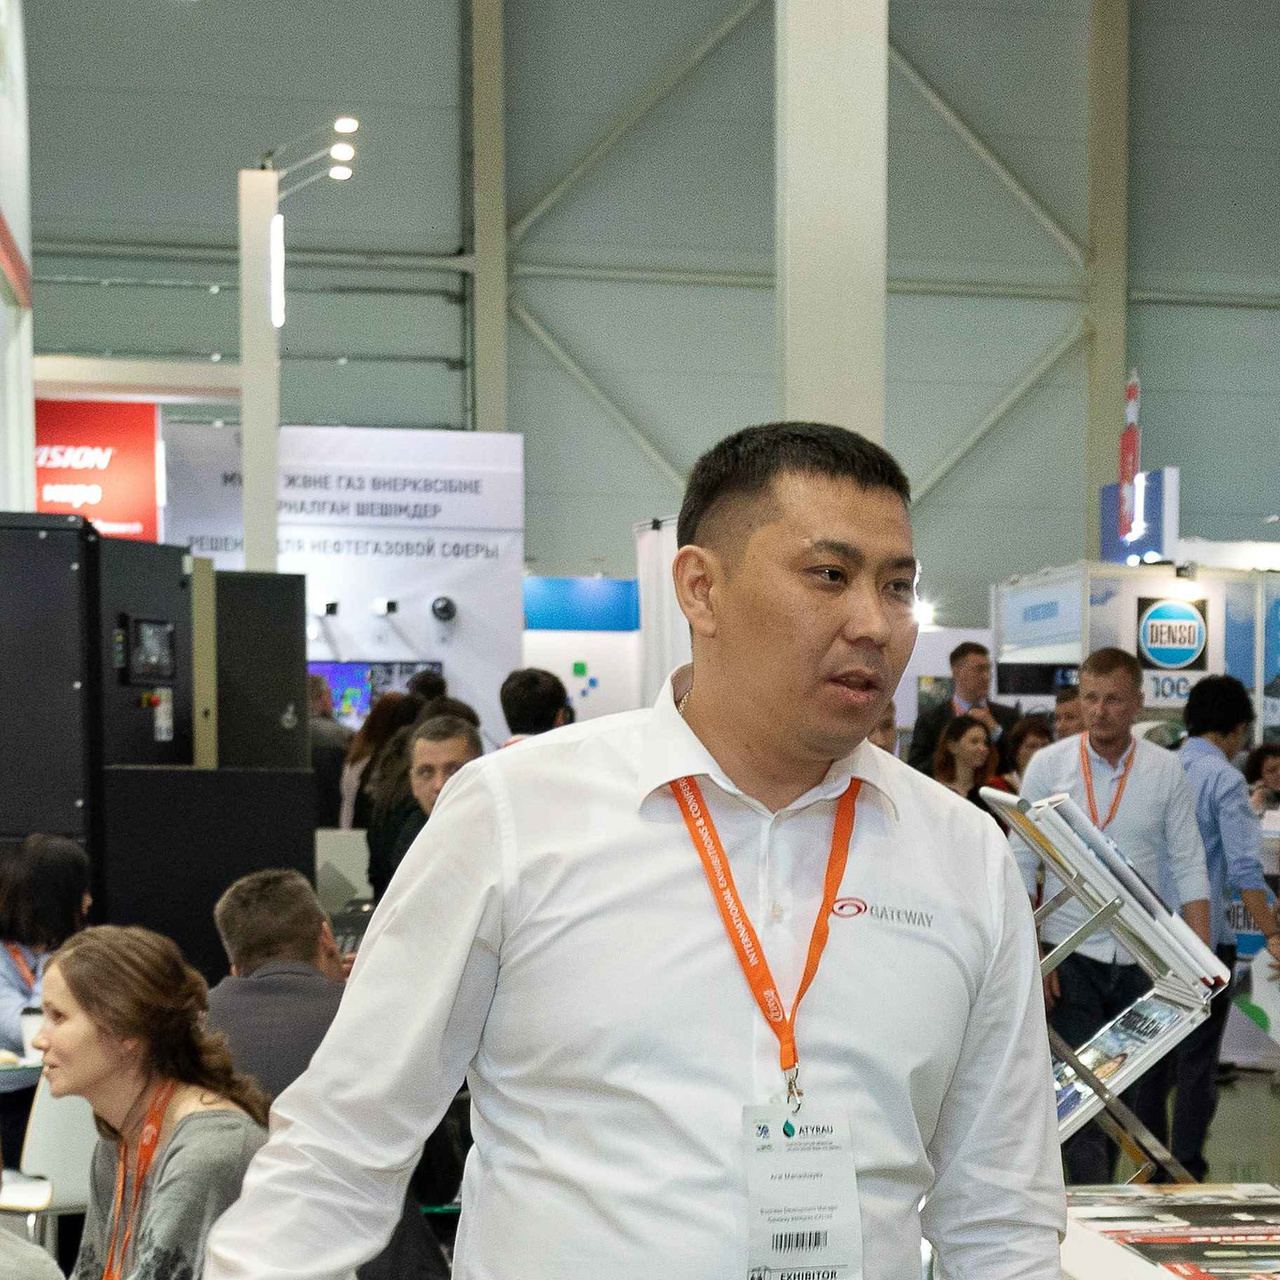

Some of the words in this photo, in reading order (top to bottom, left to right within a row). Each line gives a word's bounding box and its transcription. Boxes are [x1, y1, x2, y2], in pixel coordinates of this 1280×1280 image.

[441, 541, 500, 560] СФЕРЫ
[1149, 622, 1197, 646] DENSO
[699, 825, 728, 890] EXHIBITIONS
[722, 886, 759, 968] INTERNATIONAL
[869, 904, 935, 929] GATEWAY
[799, 1124, 835, 1135] ATYRAU
